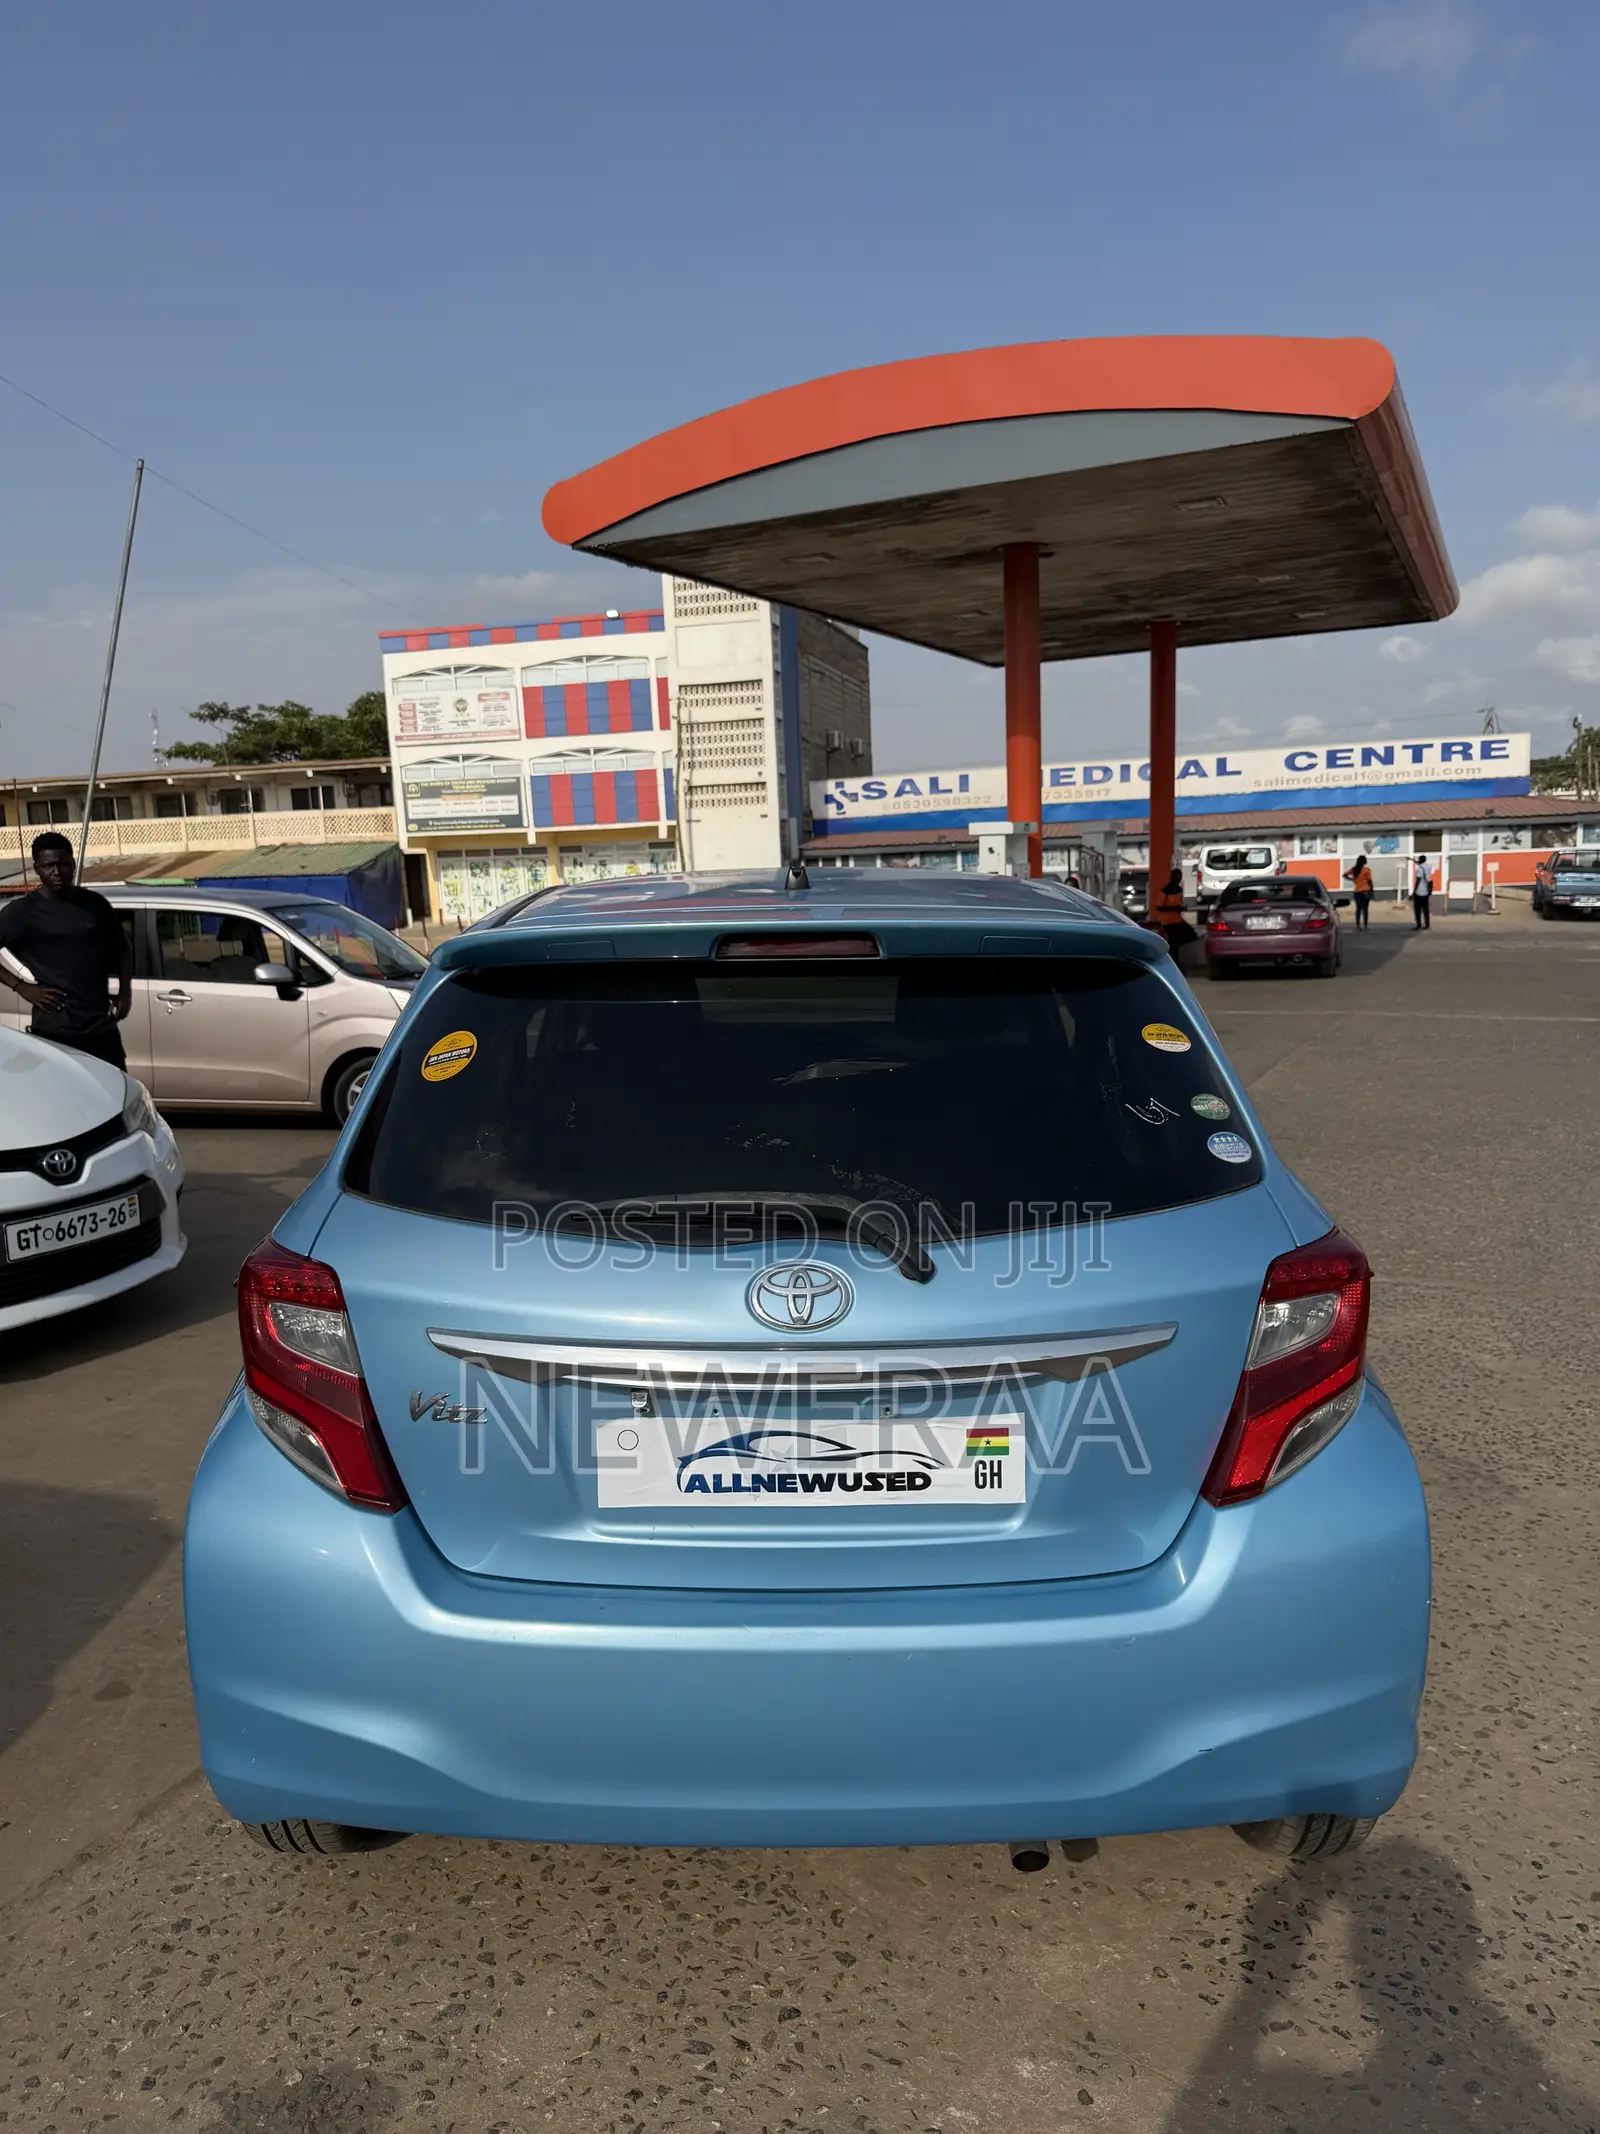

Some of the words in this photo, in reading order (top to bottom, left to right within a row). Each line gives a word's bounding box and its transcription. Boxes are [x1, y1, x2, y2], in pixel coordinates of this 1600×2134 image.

[862, 774, 969, 800] SALI
[1041, 757, 1242, 787] EDIAL
[1284, 739, 1510, 772] CENTRE
[1252, 766, 1482, 788] salimedical1@gmail.com
[16, 1223, 42, 1251] GT
[55, 1202, 126, 1242] 6673-26
[128, 1208, 138, 1219] GH
[409, 1390, 488, 1424] Vitz
[682, 1470, 932, 1494] ALLNEWUSED
[973, 1459, 1003, 1489] GH
